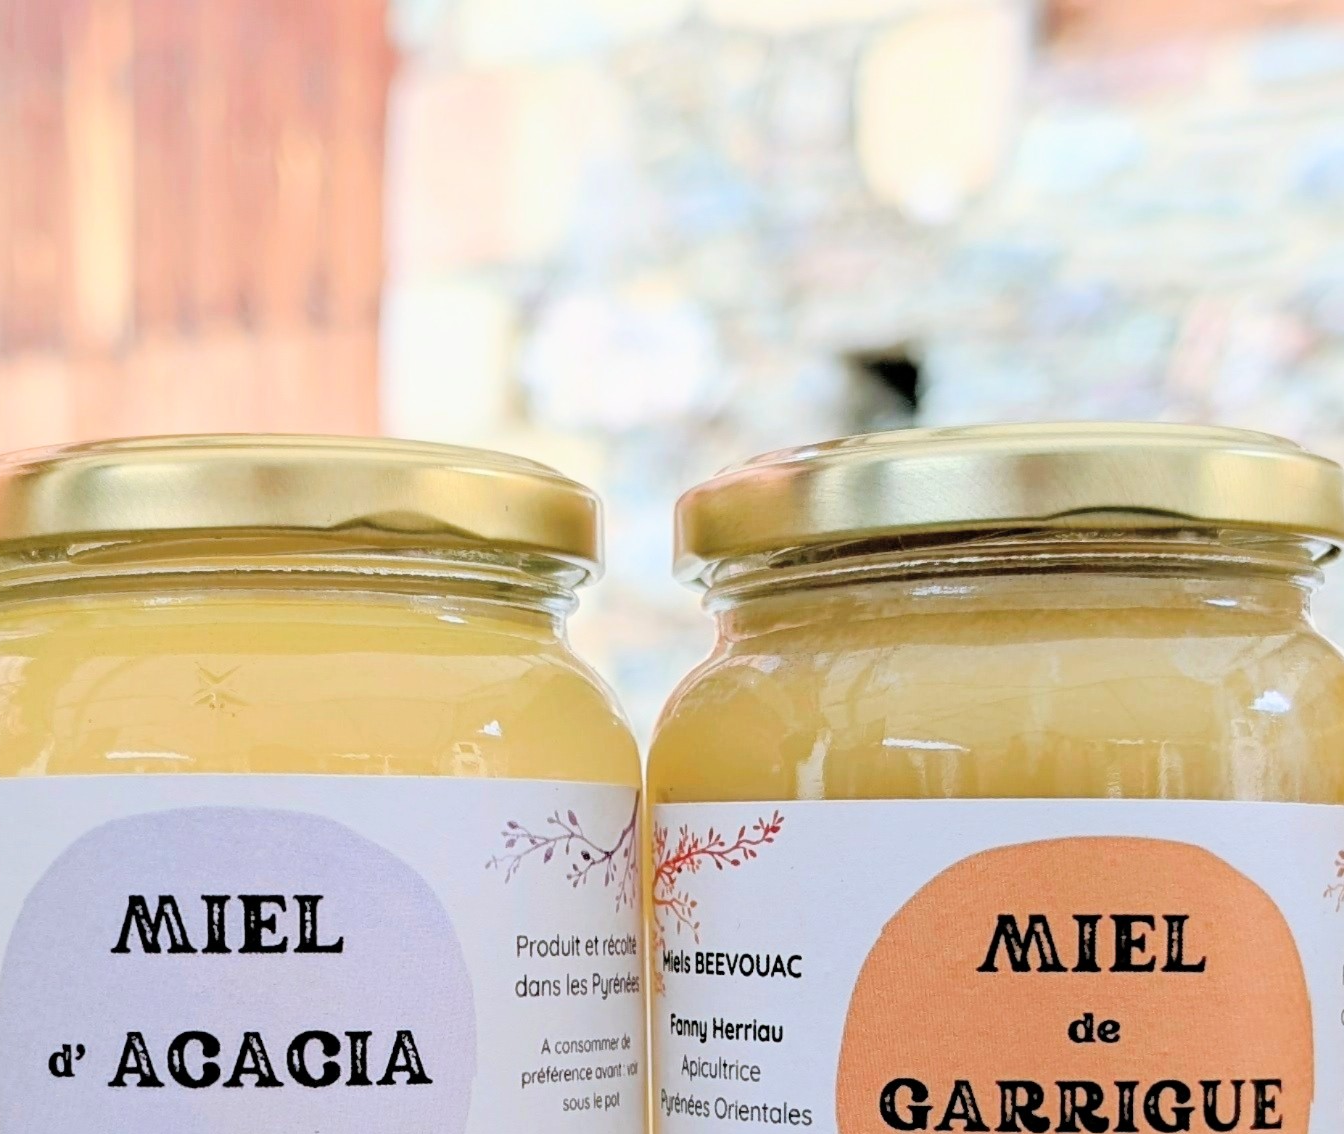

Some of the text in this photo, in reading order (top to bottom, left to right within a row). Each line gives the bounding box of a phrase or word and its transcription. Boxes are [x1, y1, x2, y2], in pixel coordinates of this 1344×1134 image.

[110, 894, 344, 954] MIEL
[516, 933, 637, 958] Produit et récolté
[976, 914, 1206, 973] MIEL
[662, 949, 802, 979] Miels BEEVOUAC
[515, 971, 640, 1000] dans les Pyrénées
[670, 1013, 783, 1043] Fanny Herriau
[1067, 1013, 1121, 1043] de
[47, 1029, 433, 1088] d' ACACIA
[541, 1033, 631, 1055] A consommer de
[521, 1065, 592, 1089] préférence
[681, 1054, 761, 1082] Apicultrice
[562, 1092, 620, 1112] sous le pot
[661, 1088, 812, 1126] Pyrénées Orientales
[879, 1076, 1284, 1134] GARRIGUE
